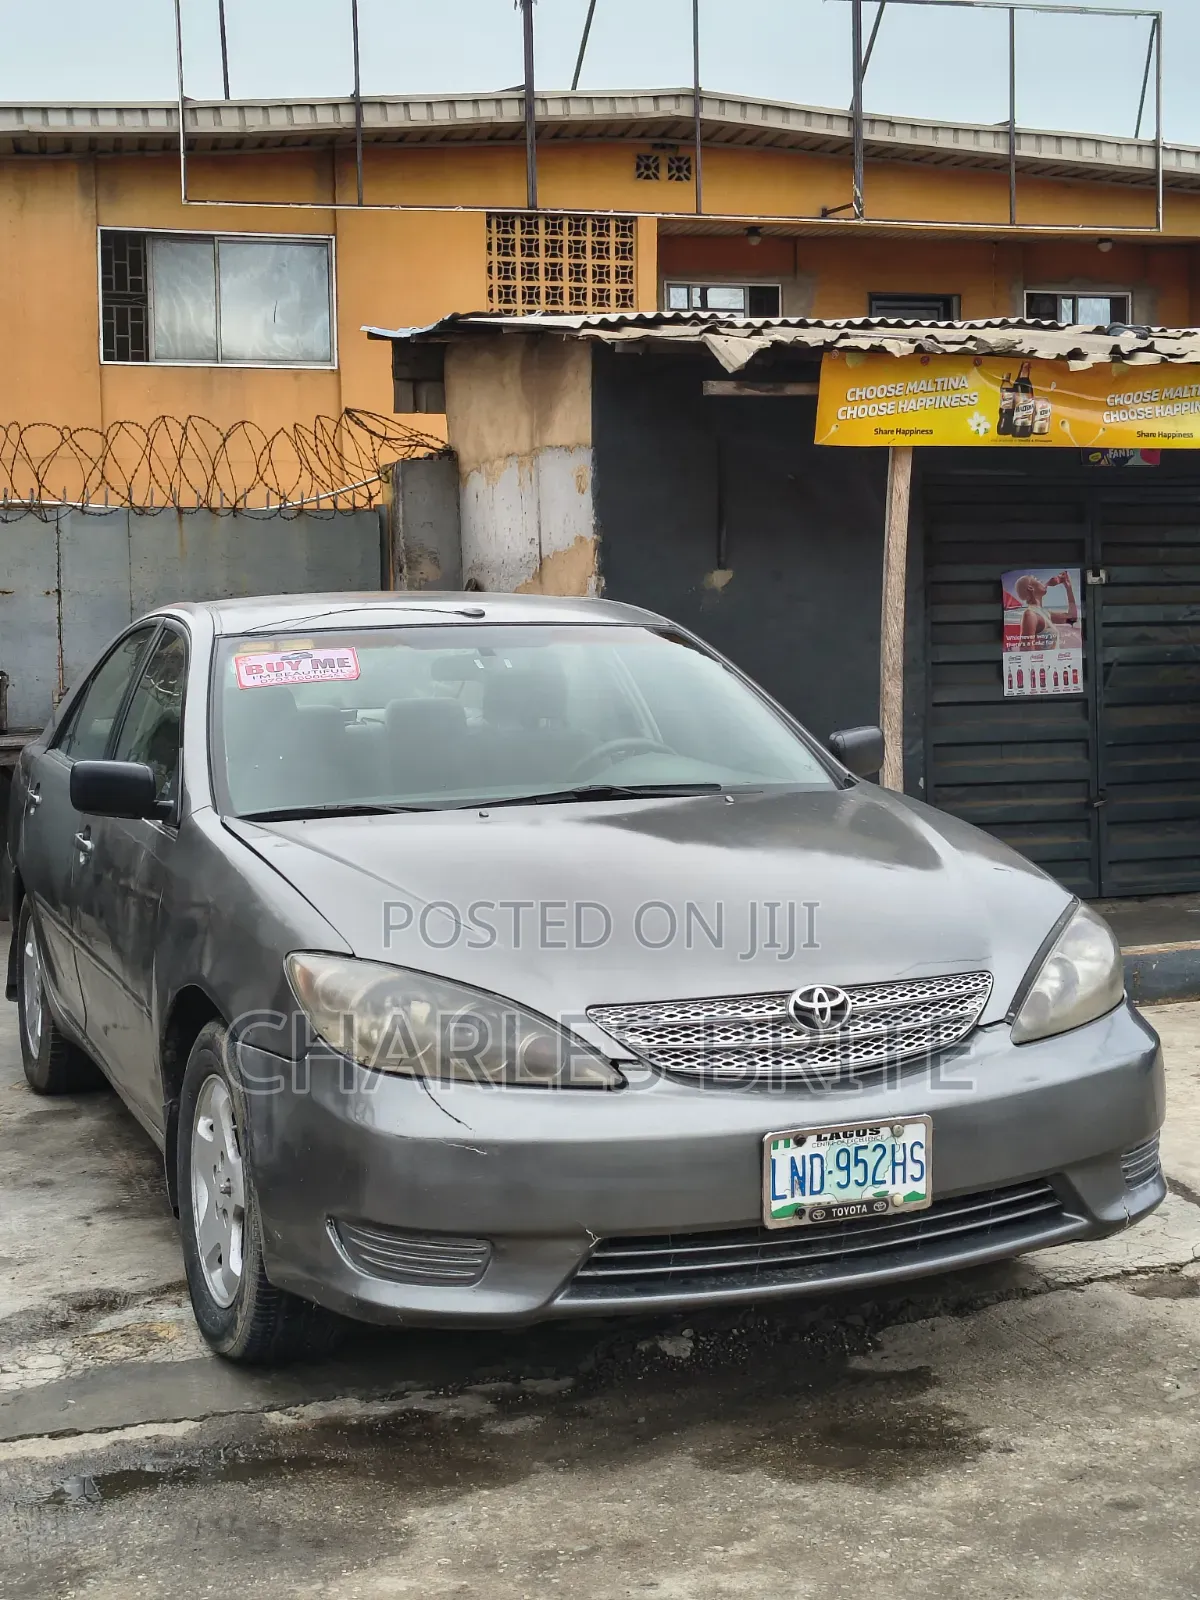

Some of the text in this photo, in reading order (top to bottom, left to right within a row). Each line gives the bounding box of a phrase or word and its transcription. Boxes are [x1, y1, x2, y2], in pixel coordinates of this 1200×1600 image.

[846, 375, 969, 402] CHOOSE MALTINA
[1106, 388, 1160, 407] CHOOSE
[837, 401, 895, 421] CHOOSE
[897, 392, 979, 413] HAPPINESS
[1103, 406, 1153, 424] CHOOSE
[874, 427, 934, 437] Share Happiness
[1158, 430, 1194, 440] Happiness
[1108, 448, 1134, 459] FANTA
[245, 658, 351, 675] BUY ME
[275, 668, 347, 678] BEAUTIFUL
[816, 1128, 880, 1142] LAGOS
[832, 1204, 867, 1217] TOYOTA
